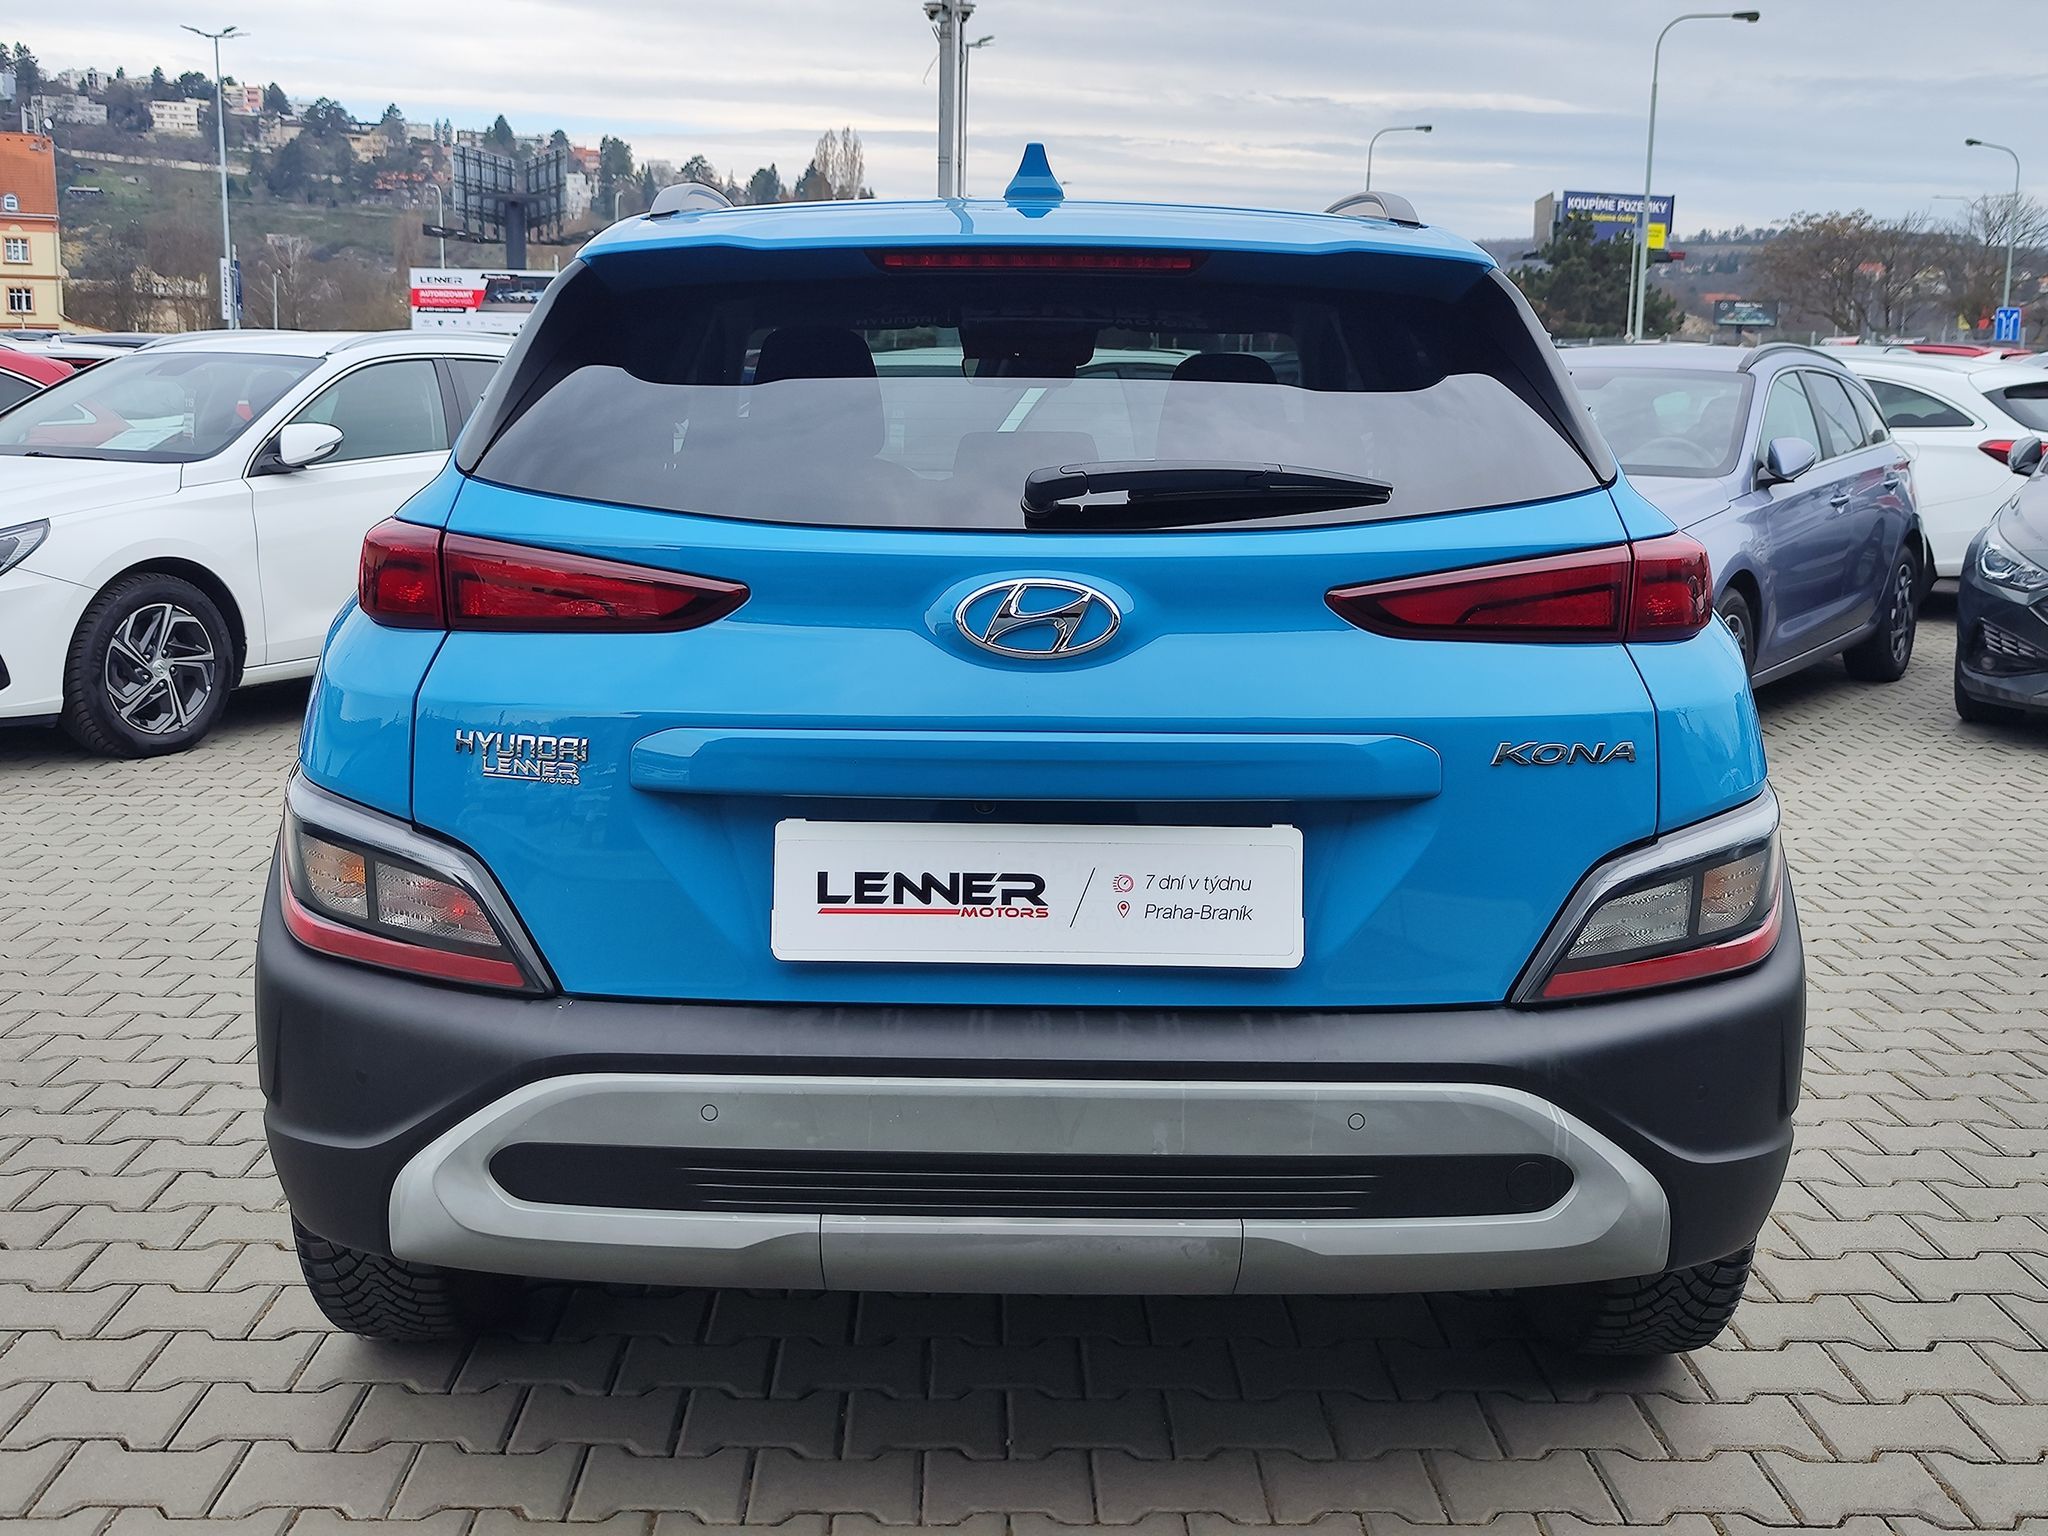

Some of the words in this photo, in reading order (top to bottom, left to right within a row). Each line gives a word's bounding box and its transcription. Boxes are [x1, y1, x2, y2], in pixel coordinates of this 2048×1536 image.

[1567, 196, 1615, 211] KOUPÍME
[420, 276, 463, 285] LENNER
[455, 729, 589, 762] HYUNDAI
[1490, 741, 1637, 766] KONA
[482, 755, 580, 780] LENNER
[540, 777, 581, 785] MOTORS
[817, 871, 1049, 906] LENNER
[1145, 874, 1156, 890] 7
[1158, 874, 1187, 891] dní
[1189, 878, 1200, 890] v
[1204, 874, 1252, 894] týdnu
[960, 906, 1049, 918] MOTORS
[1144, 903, 1254, 921] Praha-Braník
